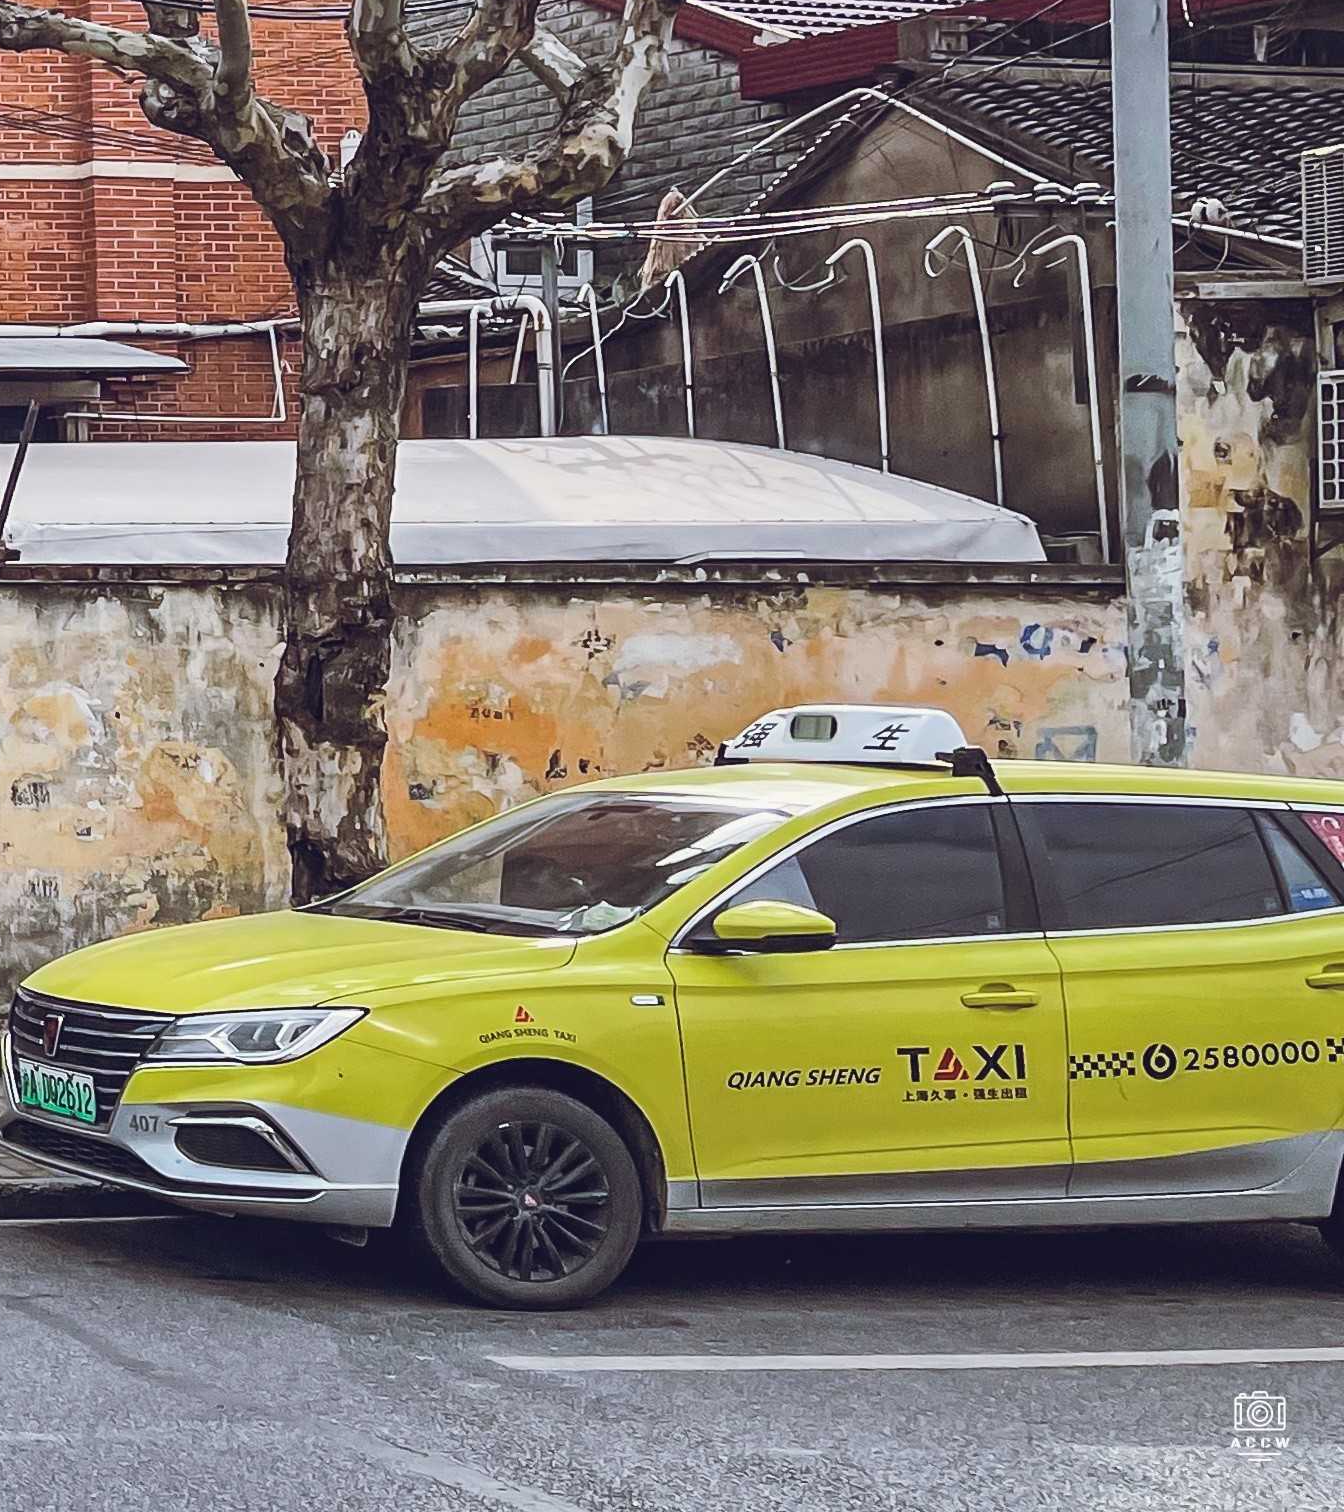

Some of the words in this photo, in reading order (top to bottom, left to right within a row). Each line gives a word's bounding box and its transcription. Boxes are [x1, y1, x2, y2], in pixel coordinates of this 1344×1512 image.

[735, 722, 778, 750] 强
[863, 723, 911, 751] 生
[479, 1029, 513, 1044] QIANG
[513, 1028, 549, 1038] SHENG
[553, 1029, 577, 1044] TAXI
[896, 1044, 1027, 1083] TAXI
[1183, 1040, 1320, 1071] 2580000
[727, 1070, 801, 1090] QIANG
[805, 1067, 882, 1087] SHENG
[129, 1114, 161, 1133] 407
